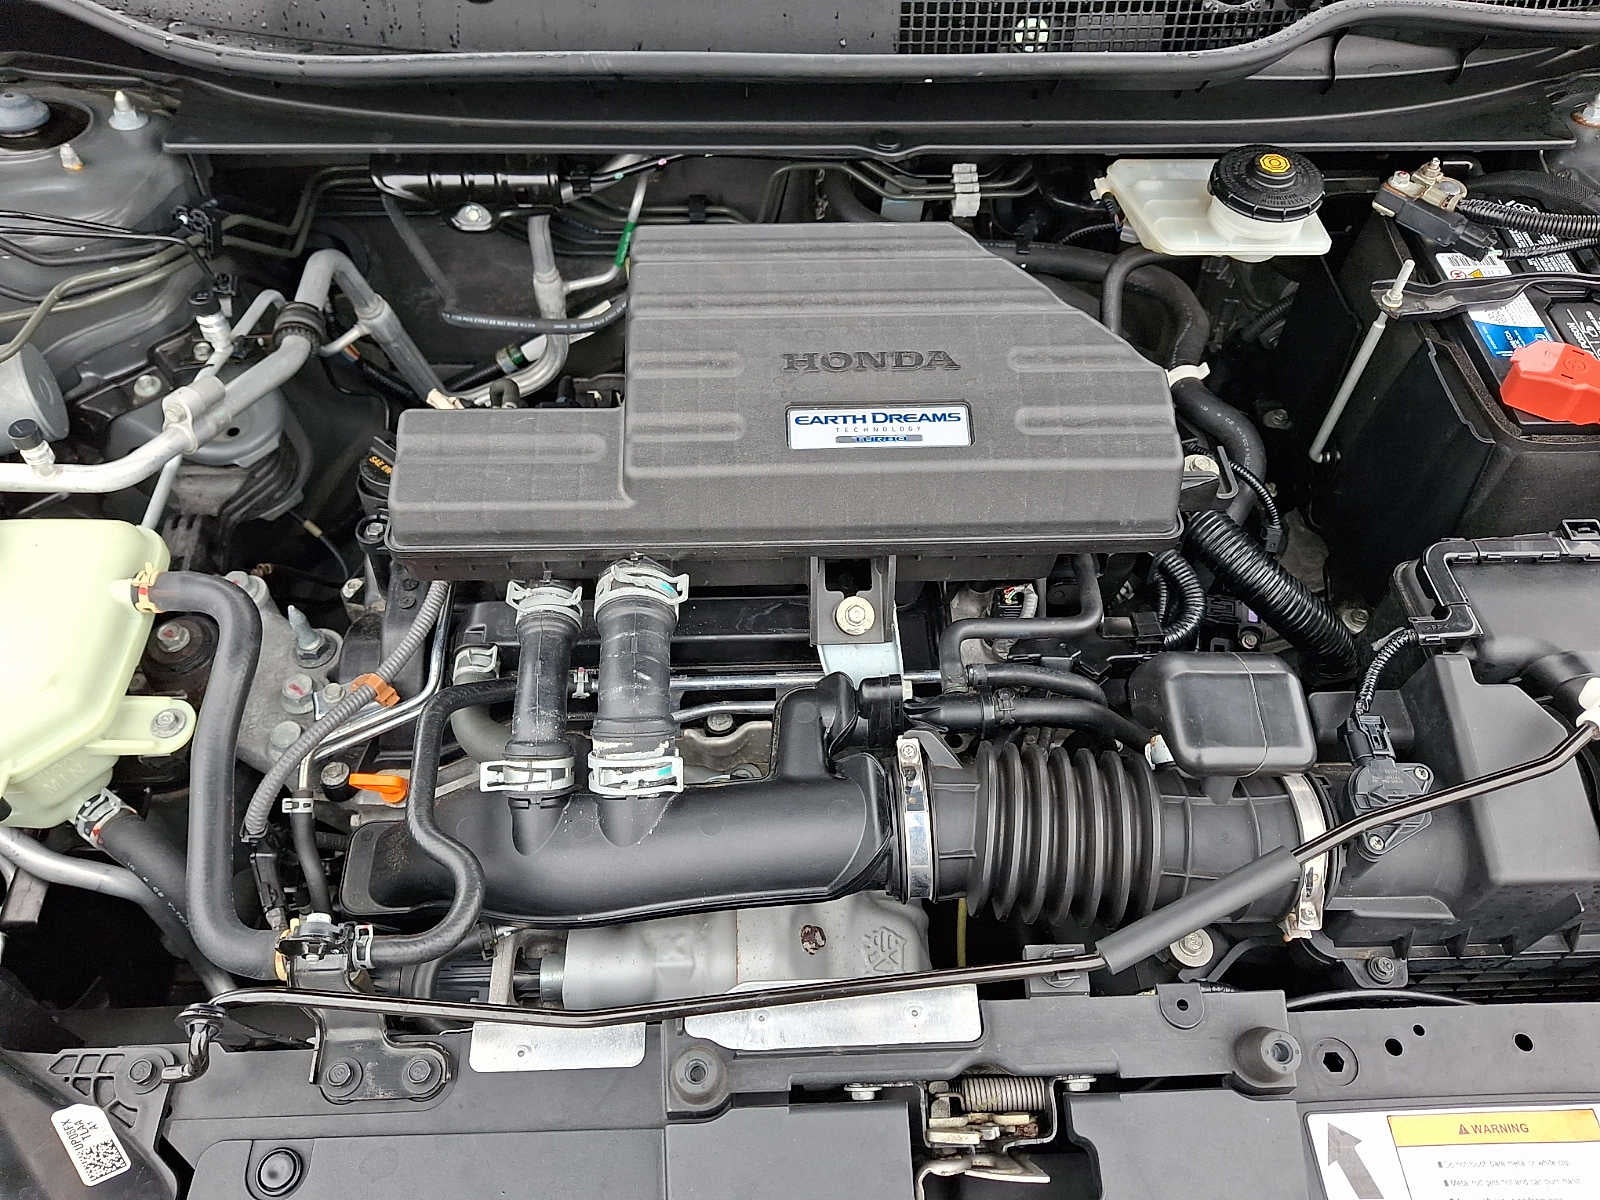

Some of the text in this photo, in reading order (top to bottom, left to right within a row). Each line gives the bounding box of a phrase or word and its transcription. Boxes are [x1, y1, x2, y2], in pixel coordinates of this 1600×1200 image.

[1566, 322, 1591, 349] POISON
[781, 350, 961, 372] HONDA
[794, 412, 961, 425] EARTH DREAMS
[836, 425, 921, 433] TECHNOLOGY
[1470, 1122, 1529, 1134] WARNING
